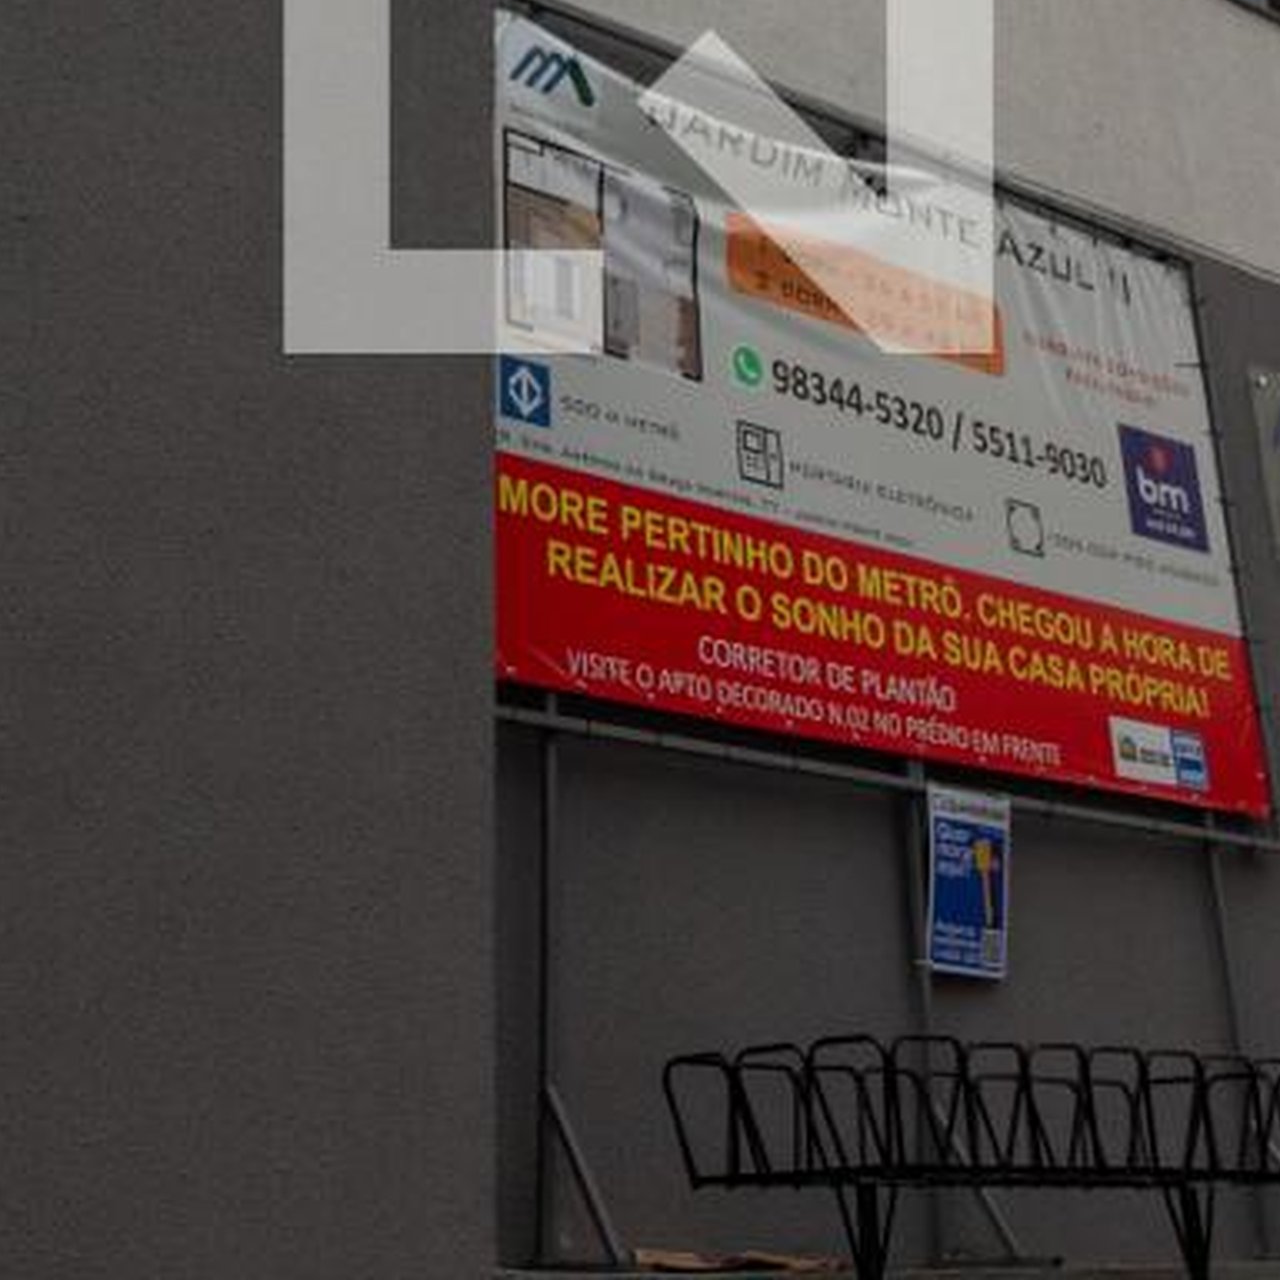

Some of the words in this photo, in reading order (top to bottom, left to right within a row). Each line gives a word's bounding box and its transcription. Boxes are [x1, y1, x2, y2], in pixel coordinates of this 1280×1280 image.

[996, 228, 1095, 291] AZUL
[772, 359, 944, 440] 98344-5320
[972, 421, 1107, 489] 5511-9030
[498, 474, 609, 535] MORE
[621, 505, 794, 579] PERTINHO
[803, 550, 848, 592] DO
[976, 592, 1094, 651] CHEGOU
[1099, 625, 1119, 655] A
[1124, 629, 1194, 674] HORA
[1198, 645, 1234, 681] DE
[547, 539, 728, 615] REALIZAR
[736, 585, 762, 621] O
[771, 593, 886, 650] SONHO
[894, 620, 937, 661] DA
[943, 631, 1005, 676] SUA
[1008, 647, 1086, 694] CASA
[1089, 664, 1209, 719] PRÓPRIA!
[566, 646, 632, 684] VISITE
[635, 664, 655, 688] O
[658, 669, 712, 701] APTO
[719, 681, 824, 722] DECORADO
[872, 709, 902, 737] NO
[905, 713, 969, 750] PRÉDIO
[972, 728, 1002, 755] EM
[1005, 733, 1062, 767] FRENTE
[698, 635, 821, 683] CORRETOR
[825, 661, 857, 694] DE
[861, 669, 957, 713] PLANTÃO
